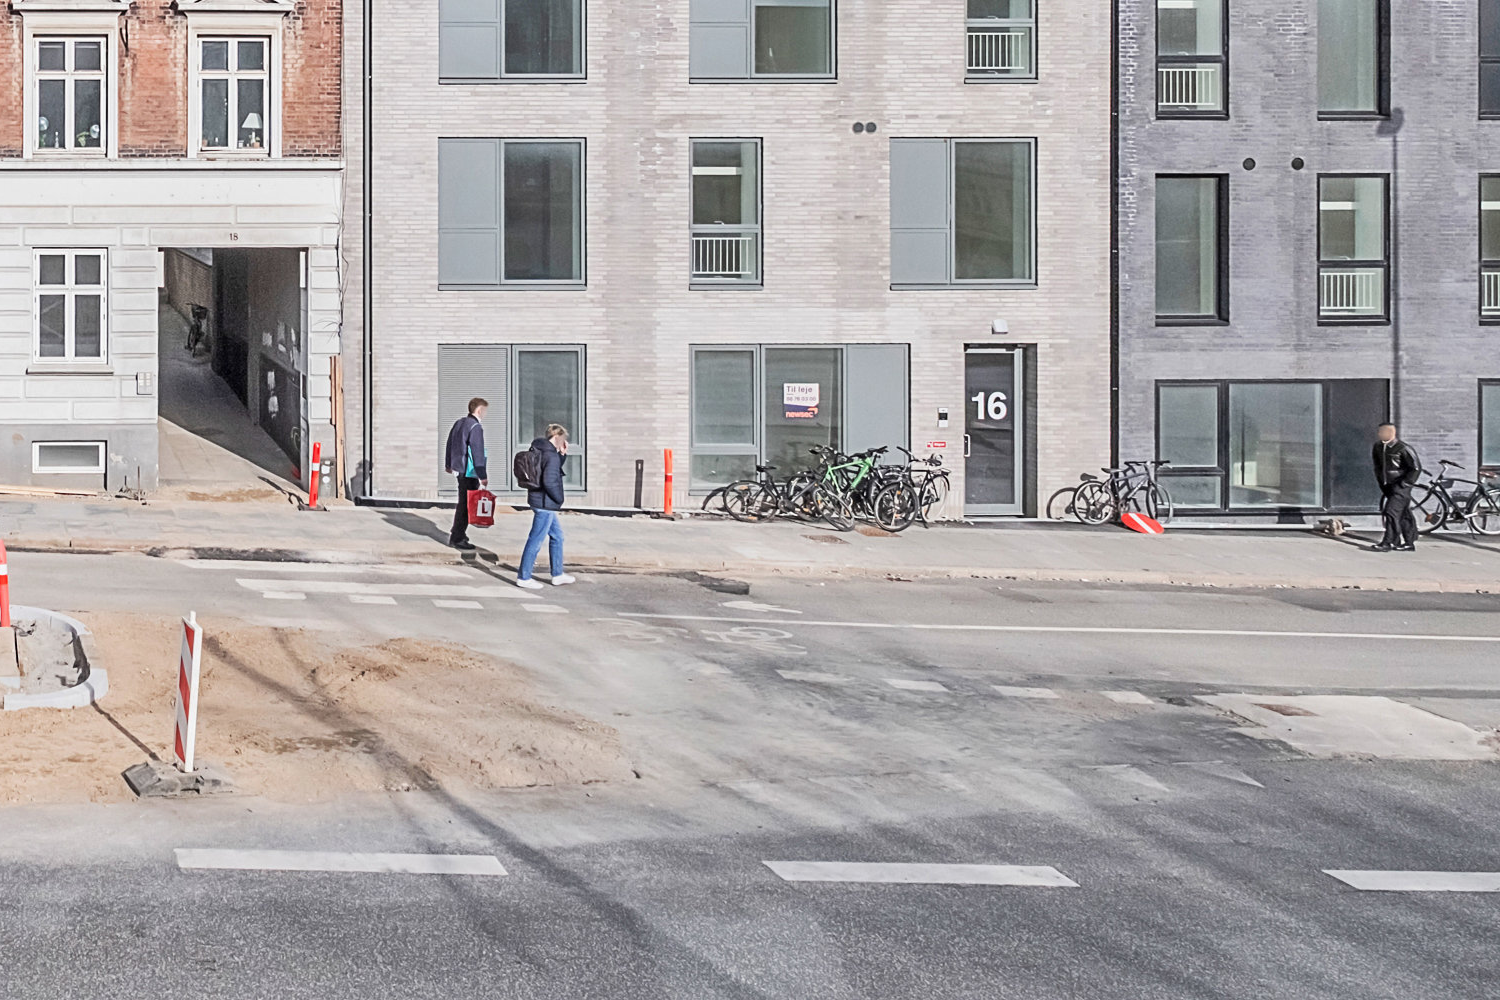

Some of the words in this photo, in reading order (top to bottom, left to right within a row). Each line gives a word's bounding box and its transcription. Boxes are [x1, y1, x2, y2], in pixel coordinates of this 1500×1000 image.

[229, 232, 239, 241] 18
[786, 385, 796, 393] Til
[798, 385, 813, 394] leje
[971, 391, 1007, 420] 16
[481, 502, 489, 514] L
